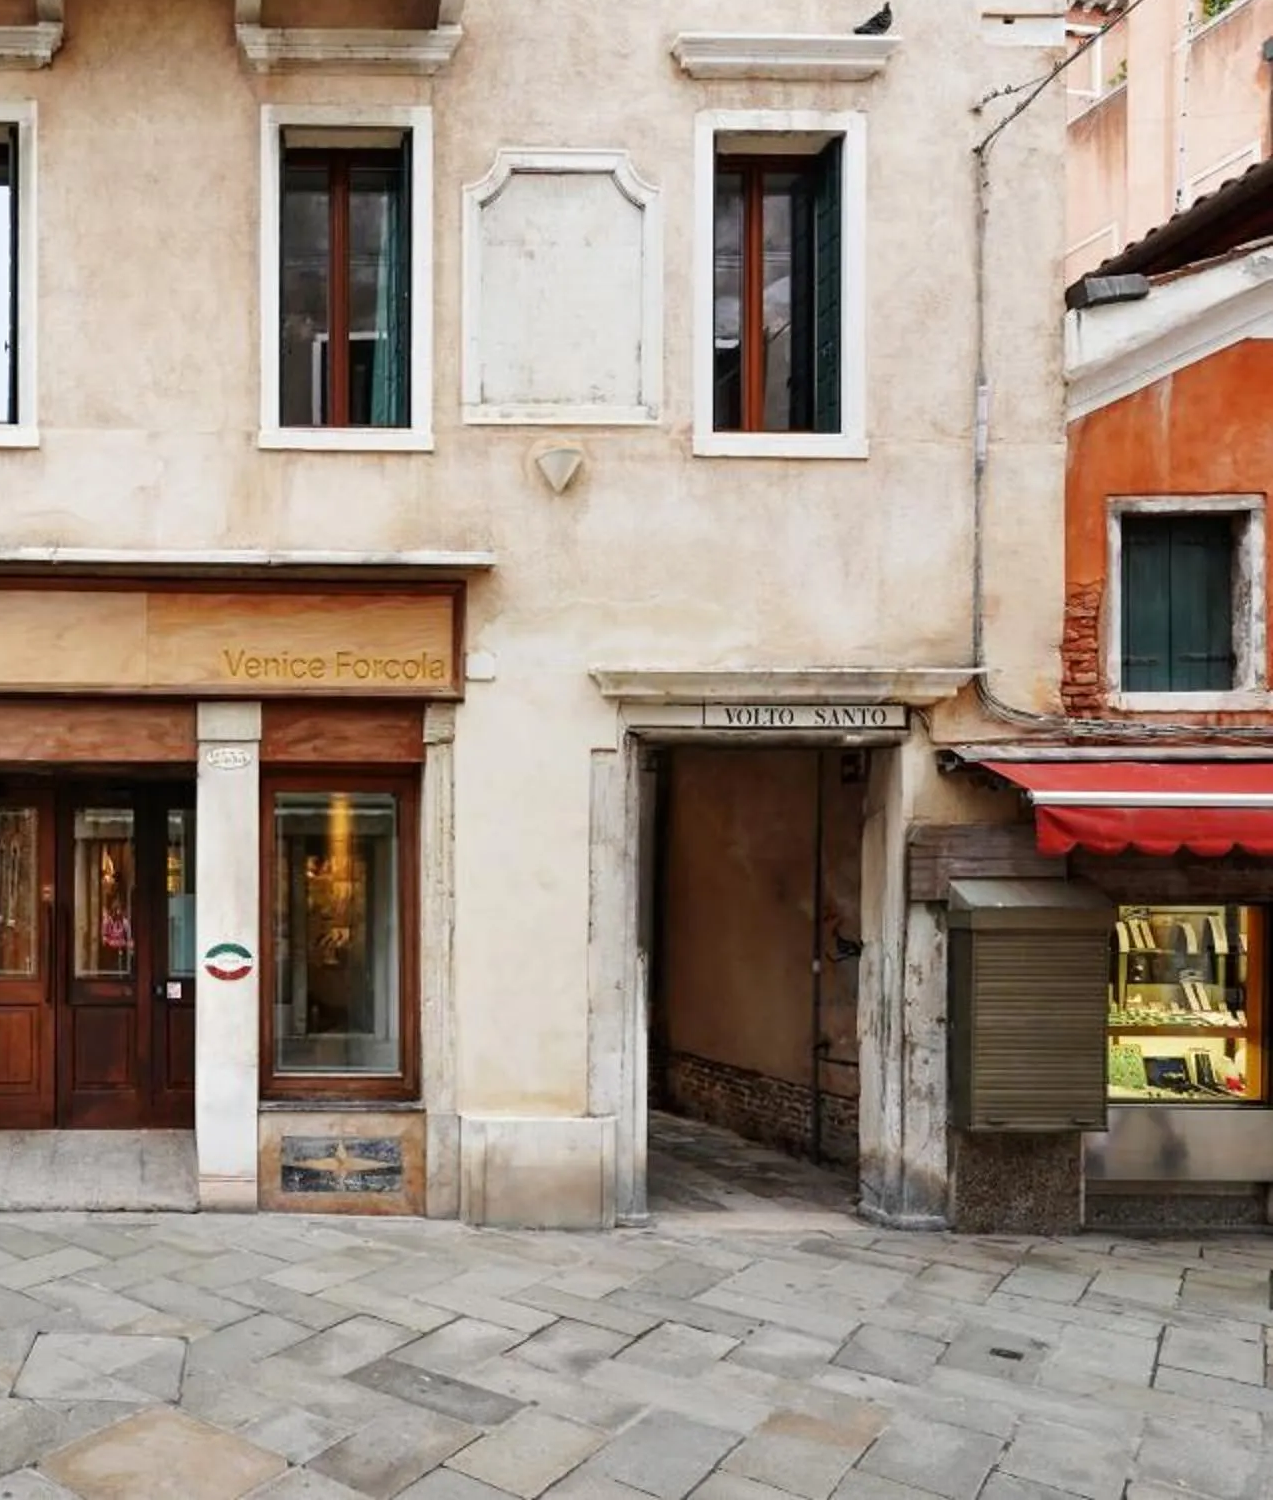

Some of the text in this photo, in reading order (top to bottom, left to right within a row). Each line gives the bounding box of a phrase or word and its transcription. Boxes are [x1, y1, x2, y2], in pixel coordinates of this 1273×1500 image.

[223, 650, 446, 680] Venice Forcola
[724, 707, 887, 725] VOLTO SANTO
